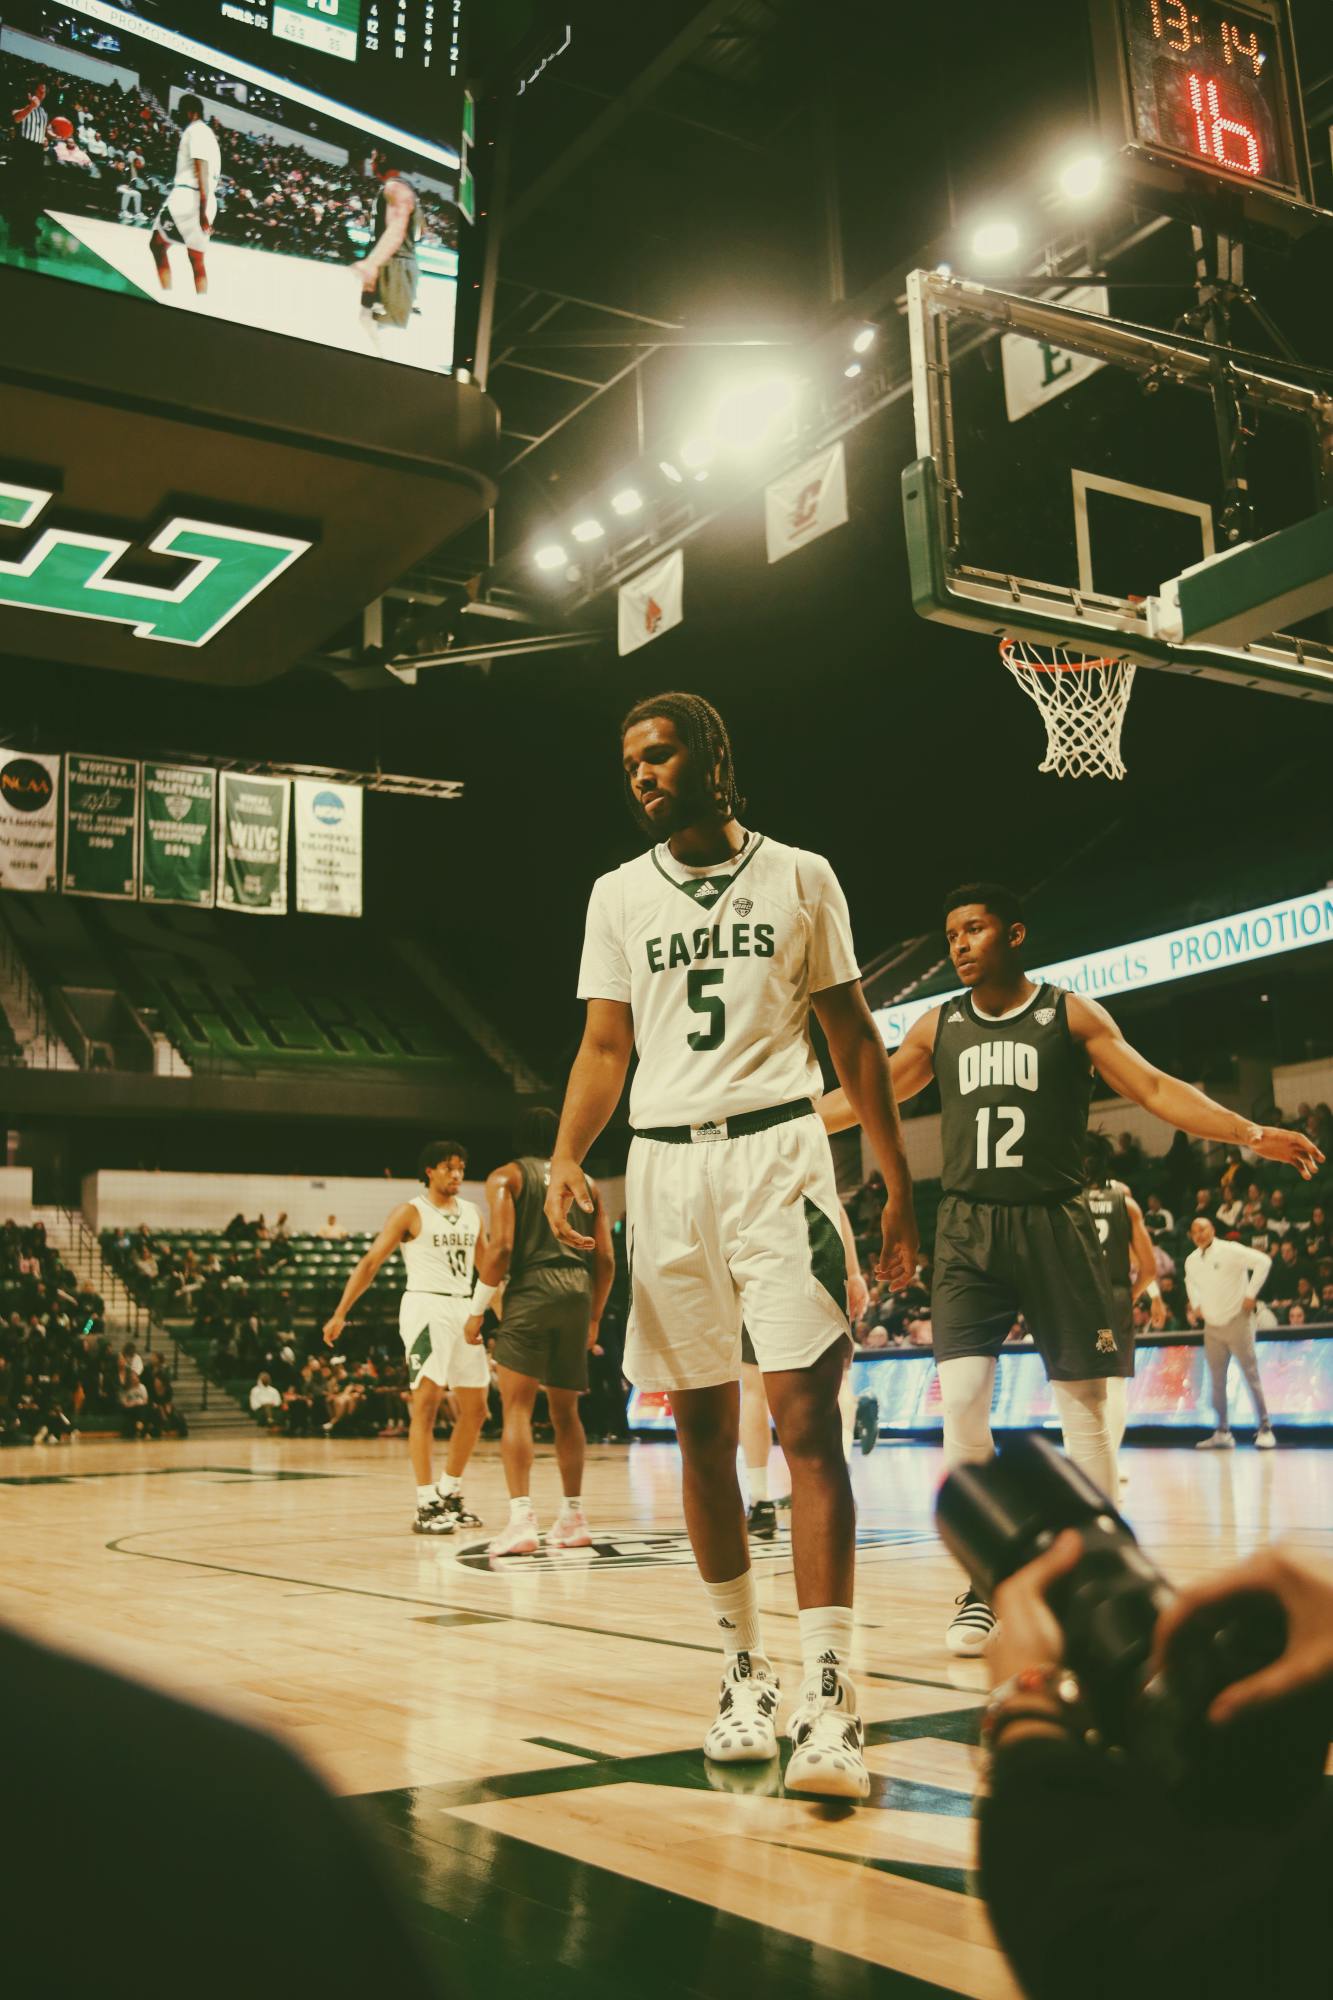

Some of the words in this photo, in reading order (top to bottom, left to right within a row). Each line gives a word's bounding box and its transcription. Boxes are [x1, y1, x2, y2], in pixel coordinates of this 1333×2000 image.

[1188, 74, 1259, 174] 16
[646, 923, 775, 974] EAGLES
[1032, 953, 1149, 994] oducts
[686, 968, 726, 1052] 5
[958, 1040, 1039, 1096] OHIO
[975, 1106, 1026, 1170] 12
[433, 1232, 475, 1248] EAGLES
